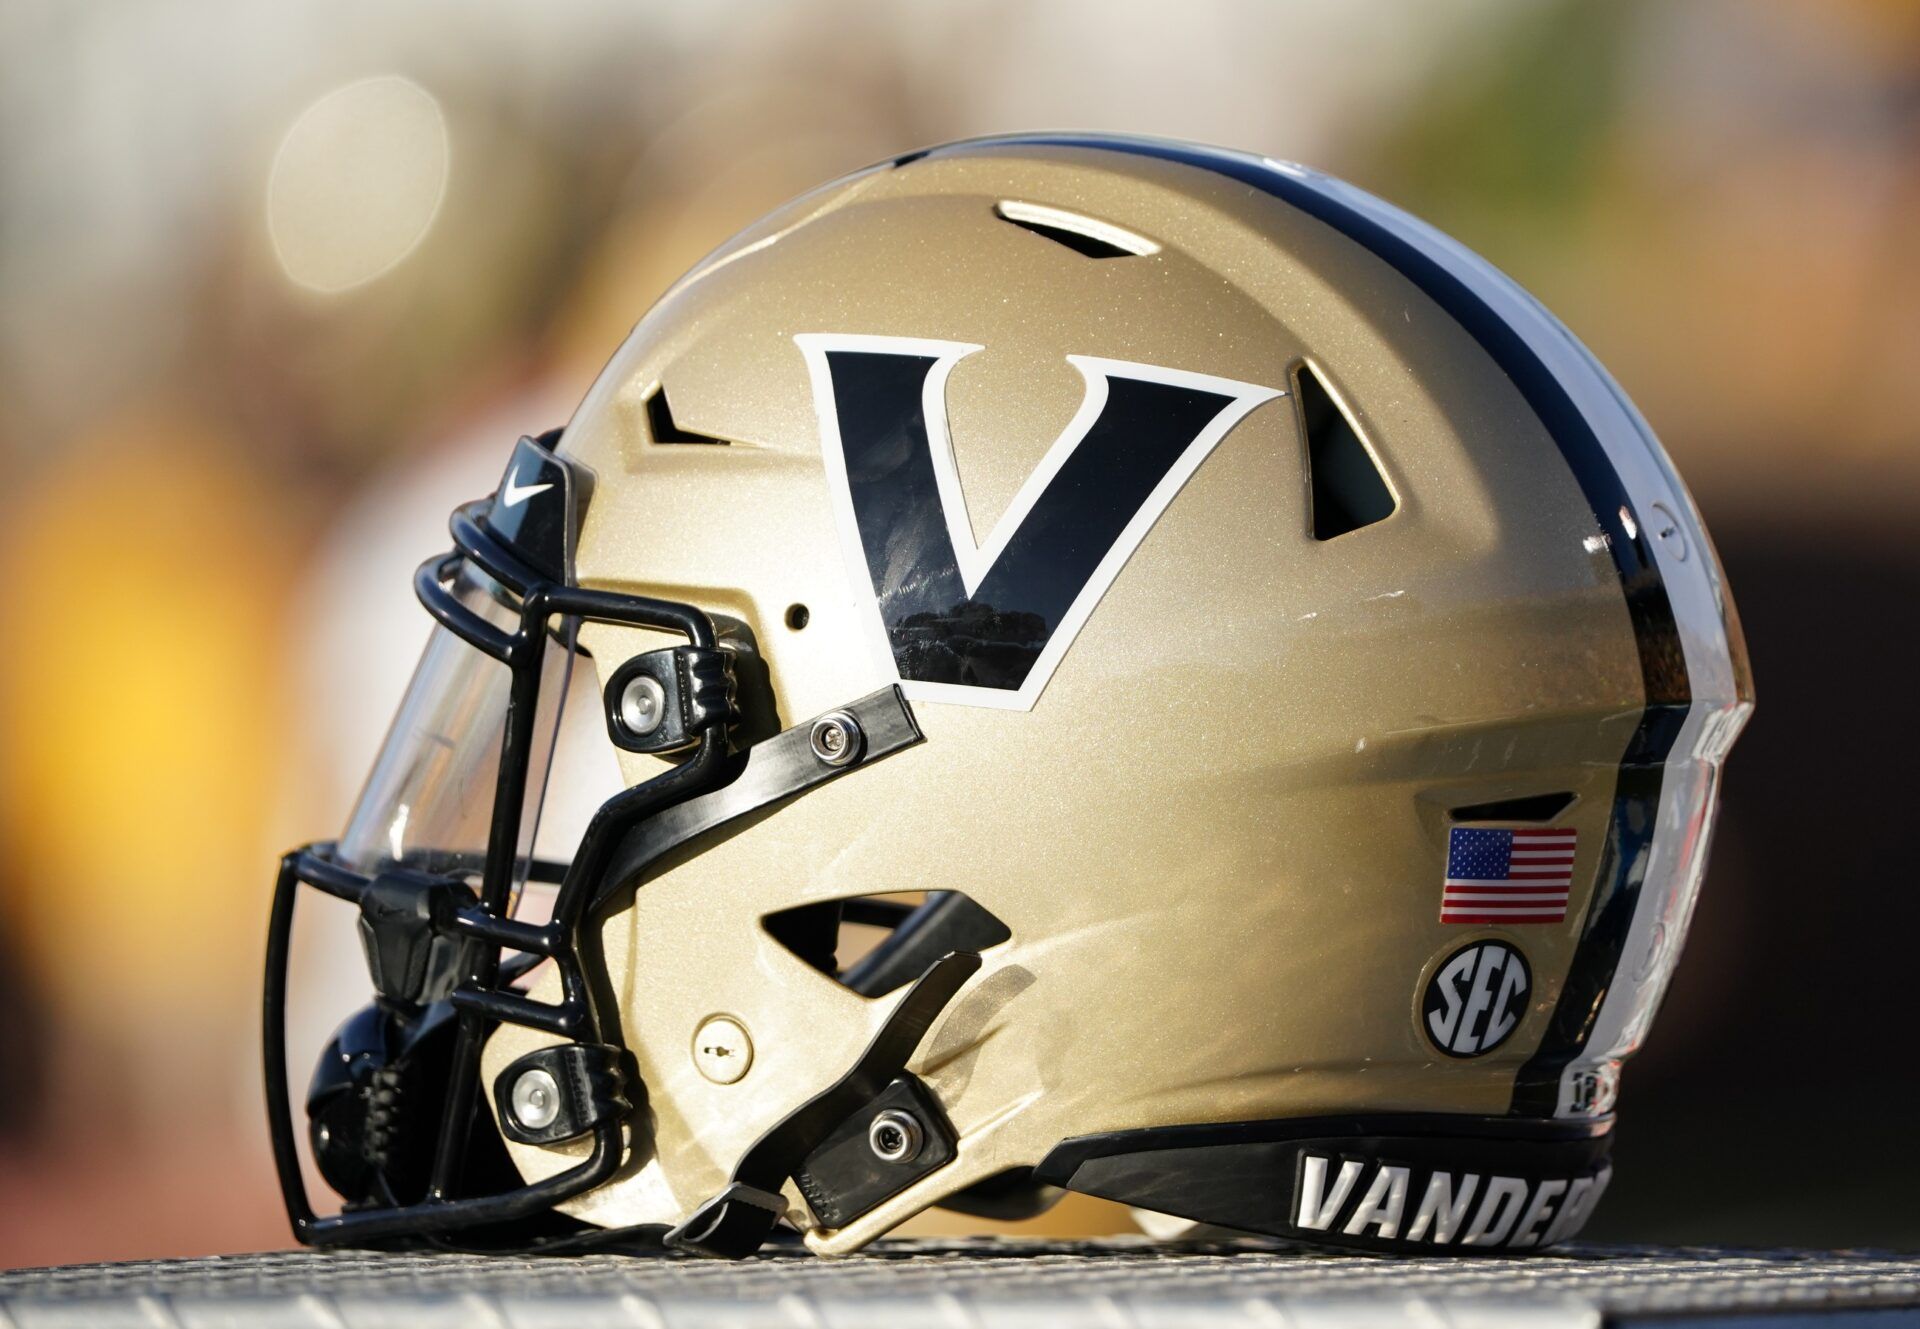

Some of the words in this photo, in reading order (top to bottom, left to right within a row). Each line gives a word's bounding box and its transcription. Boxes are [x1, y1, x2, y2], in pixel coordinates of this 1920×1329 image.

[793, 333, 1285, 712] V
[1429, 945, 1526, 1053] SEC
[1297, 1156, 1612, 1248] VANDER
